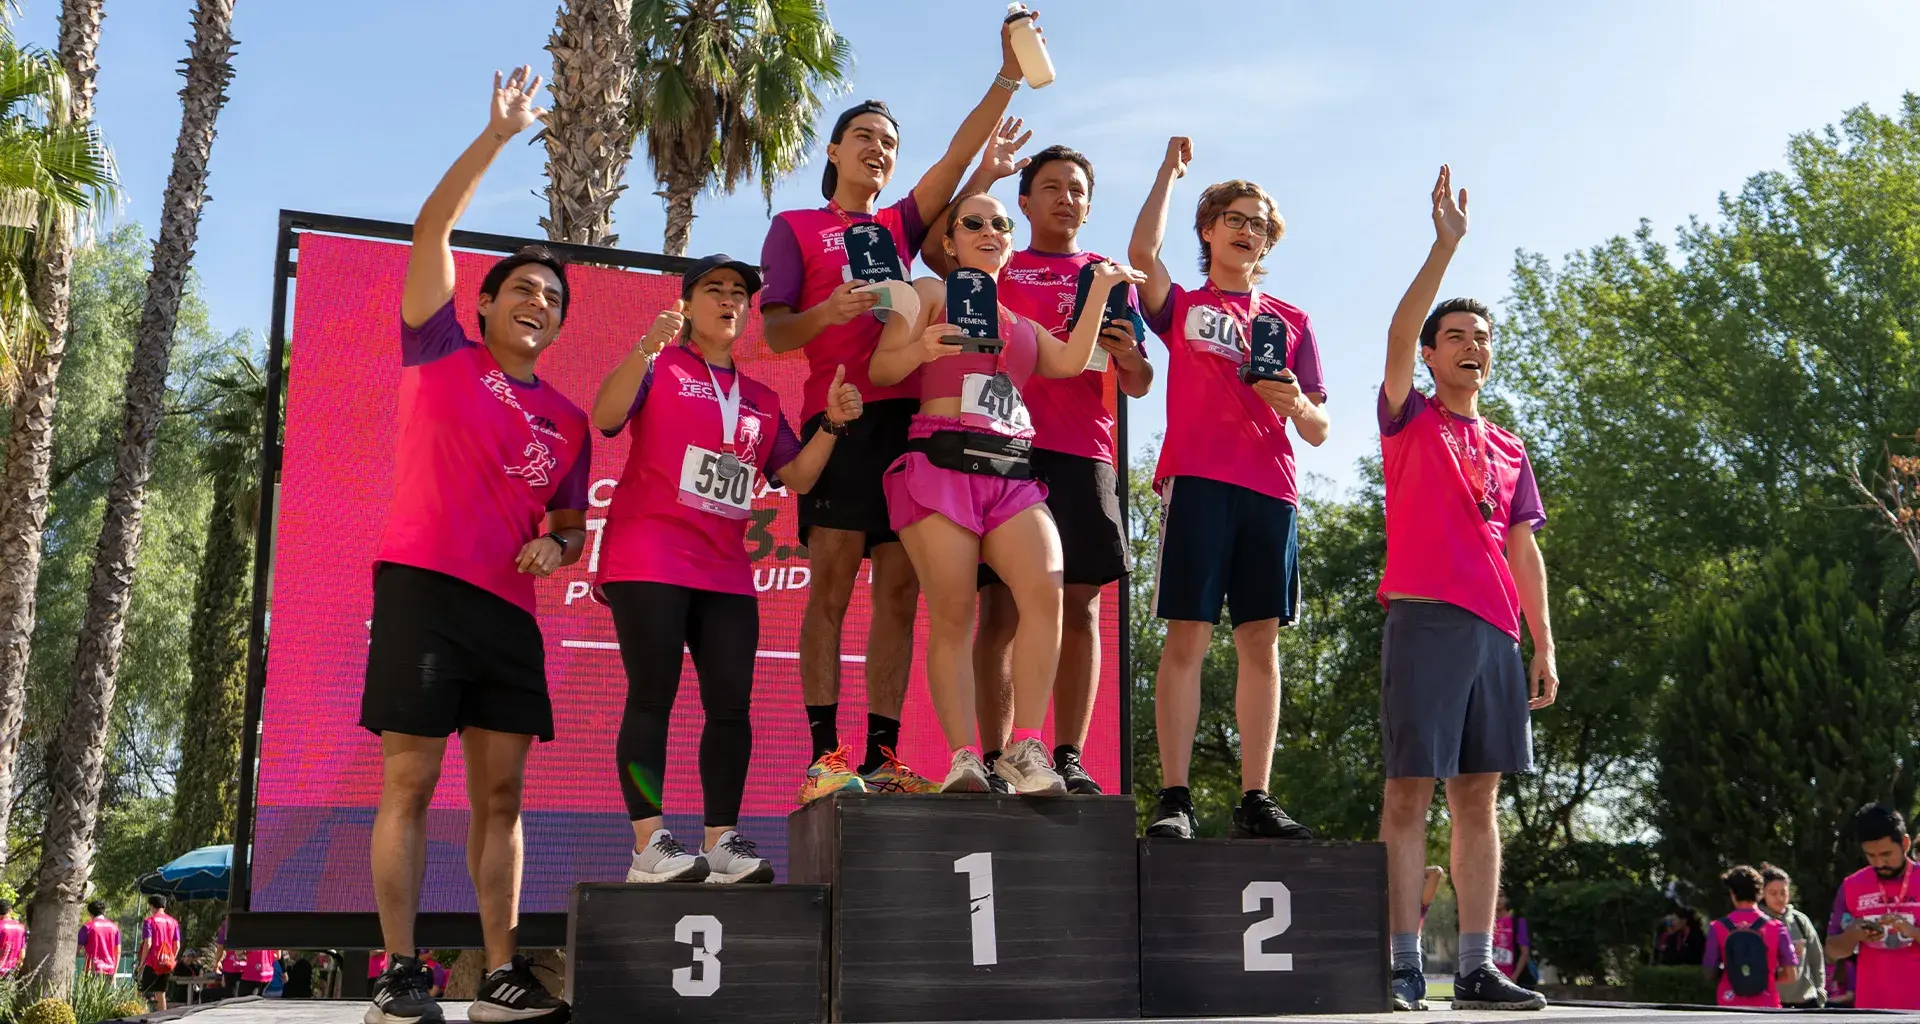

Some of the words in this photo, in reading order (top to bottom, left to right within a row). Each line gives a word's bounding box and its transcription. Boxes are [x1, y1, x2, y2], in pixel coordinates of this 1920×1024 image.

[822, 236, 845, 247] TE
[681, 382, 713, 396] TEC
[953, 851, 998, 966] 1
[1242, 881, 1293, 972] 2
[672, 914, 723, 997] 3
